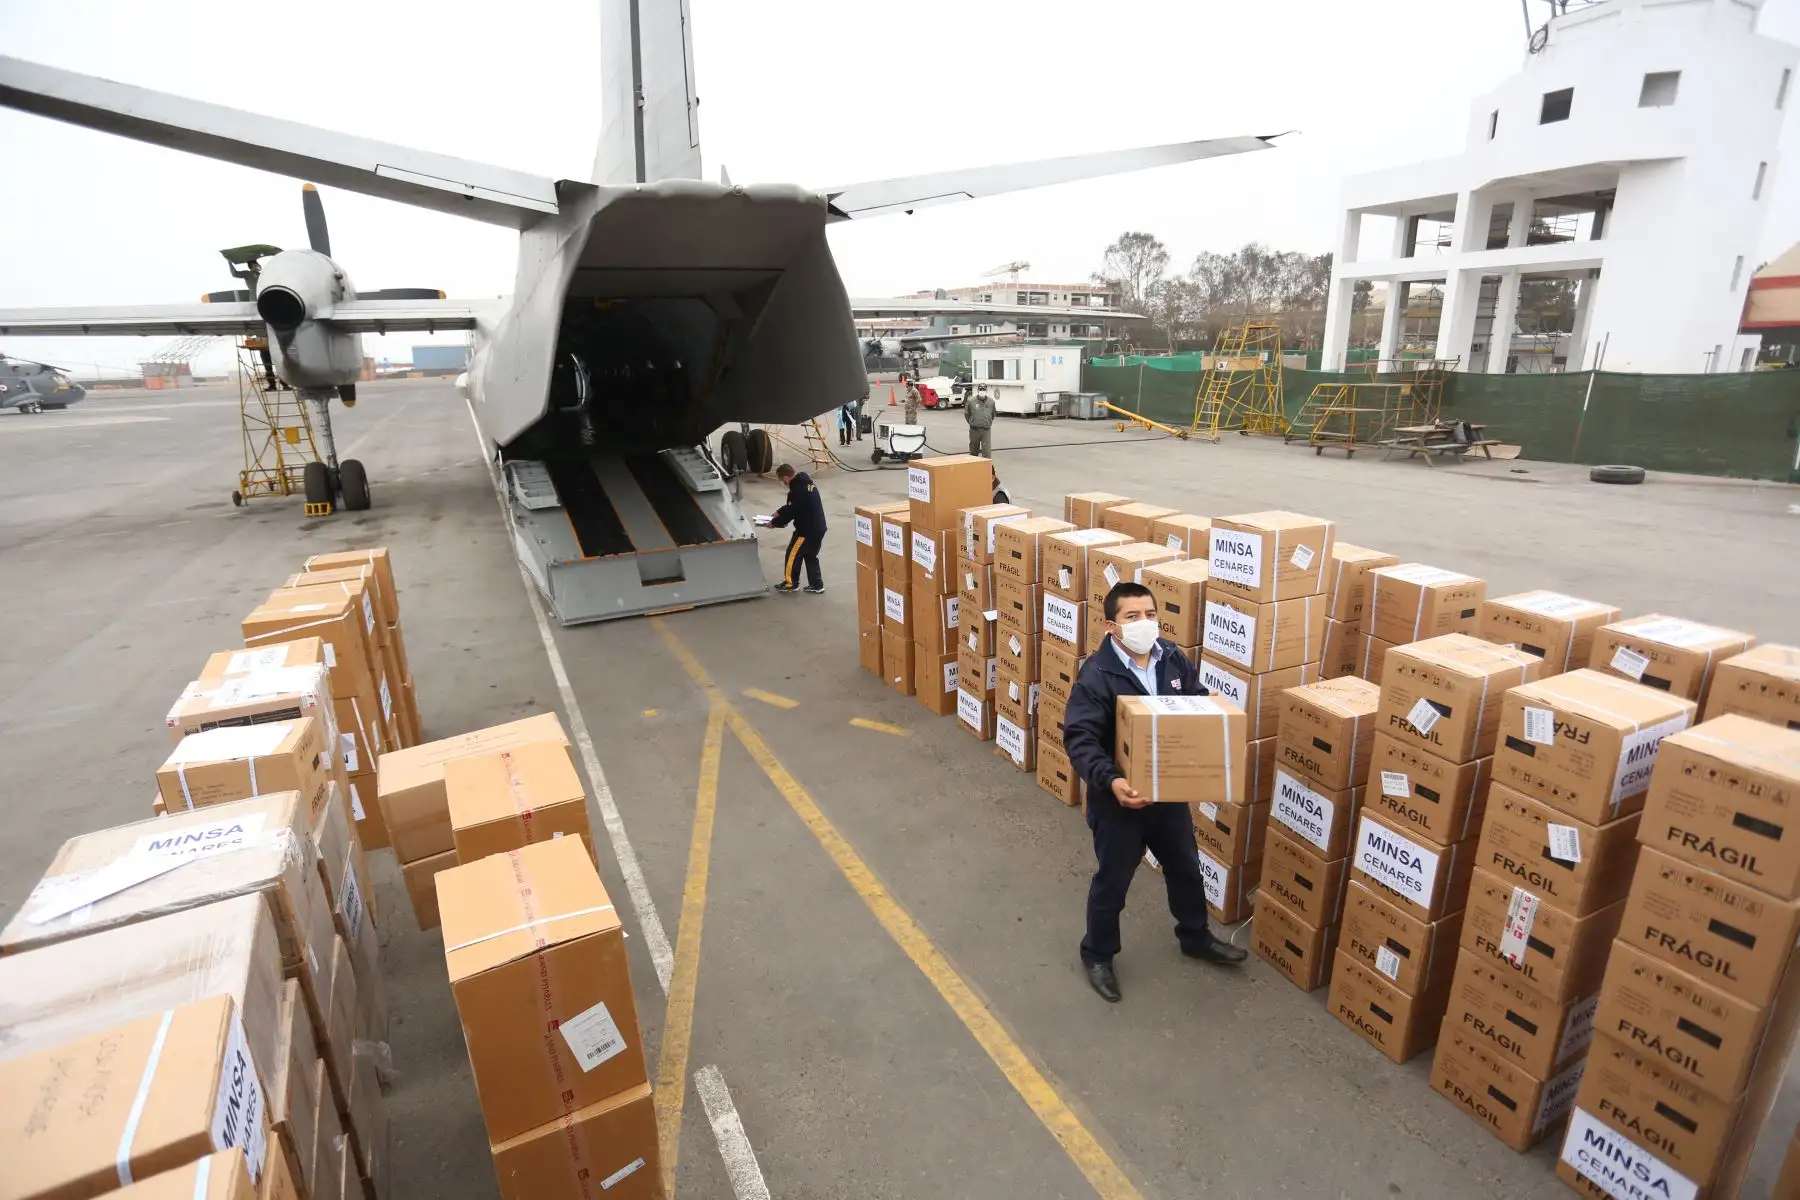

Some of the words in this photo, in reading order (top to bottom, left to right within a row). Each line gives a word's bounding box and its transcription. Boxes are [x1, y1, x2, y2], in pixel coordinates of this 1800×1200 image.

[910, 474, 927, 485] MINSA
[1215, 538, 1254, 558] MINSA
[1214, 558, 1254, 575] CENARES
[1046, 617, 1073, 634] CENARES
[1047, 602, 1073, 621] MINSA
[1210, 612, 1246, 638] MINSA
[1208, 631, 1247, 655] CENARES
[959, 695, 978, 713] MINSA
[1204, 672, 1239, 701] MINSA
[999, 722, 1021, 742] MINSA
[999, 735, 1021, 753] CENARES
[1284, 746, 1323, 776] FRÁGIL
[1278, 802, 1323, 838] CENARES
[1281, 784, 1324, 821] MINSA
[1379, 794, 1432, 830] FRÁGIL
[148, 824, 244, 852] MINSA
[1367, 832, 1423, 874] MINSA
[1667, 826, 1764, 876] FRÁGIL
[1198, 860, 1219, 884] NSA
[1363, 852, 1422, 892] CENARES
[1493, 851, 1558, 897] FRÁGIL
[1270, 879, 1309, 913] FRÁGIL
[1258, 940, 1296, 976] FRÁGIL
[1644, 926, 1738, 982] FRÁGIL
[1339, 1003, 1386, 1045] FRÁGIL
[1463, 1012, 1527, 1060] FRÁGIL
[1617, 1018, 1705, 1078] FRÁGIL
[222, 1050, 248, 1149] MINSA
[1443, 1078, 1502, 1131] FRÁGIL
[1598, 1098, 1682, 1160] FRÁGIL
[1583, 1127, 1671, 1199] MINSA
